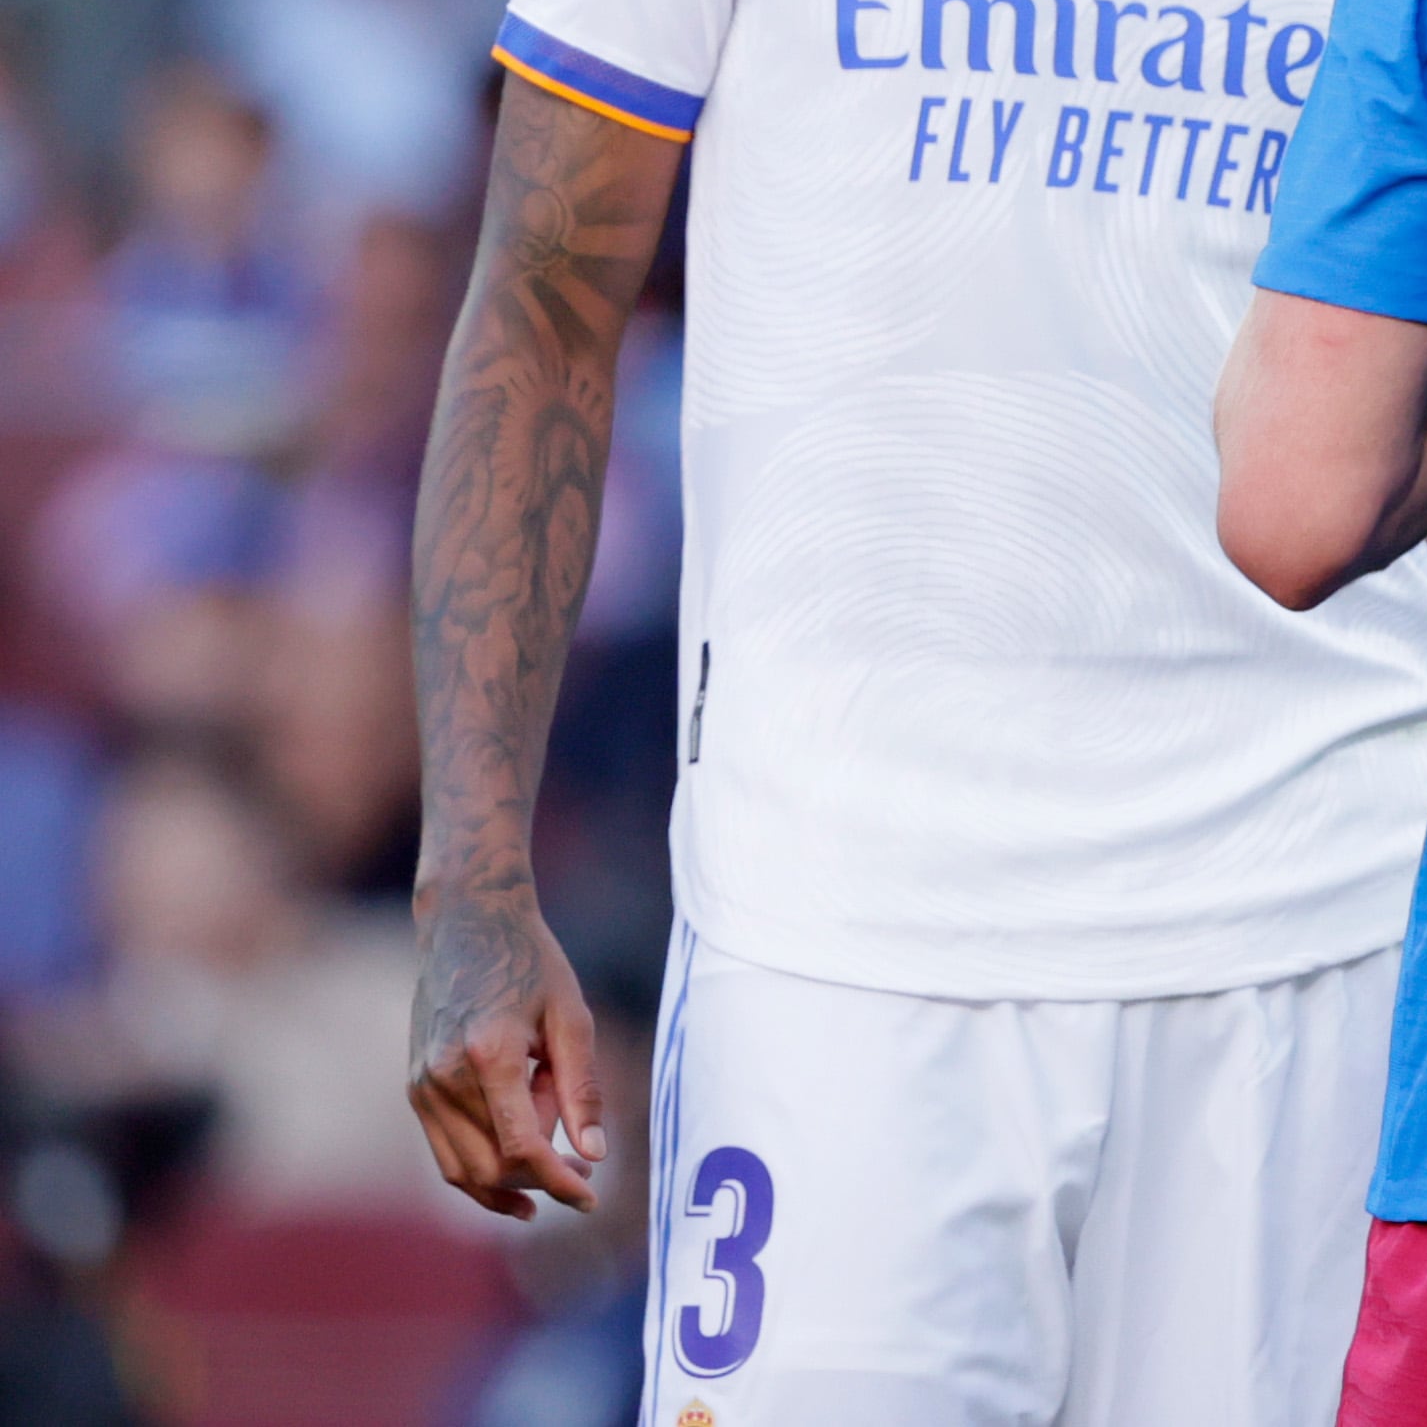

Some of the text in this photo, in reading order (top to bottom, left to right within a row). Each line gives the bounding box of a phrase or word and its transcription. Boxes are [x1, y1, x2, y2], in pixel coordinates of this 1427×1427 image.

[908, 96, 1289, 216] FLY BETTER
[672, 1145, 775, 1379] 3
